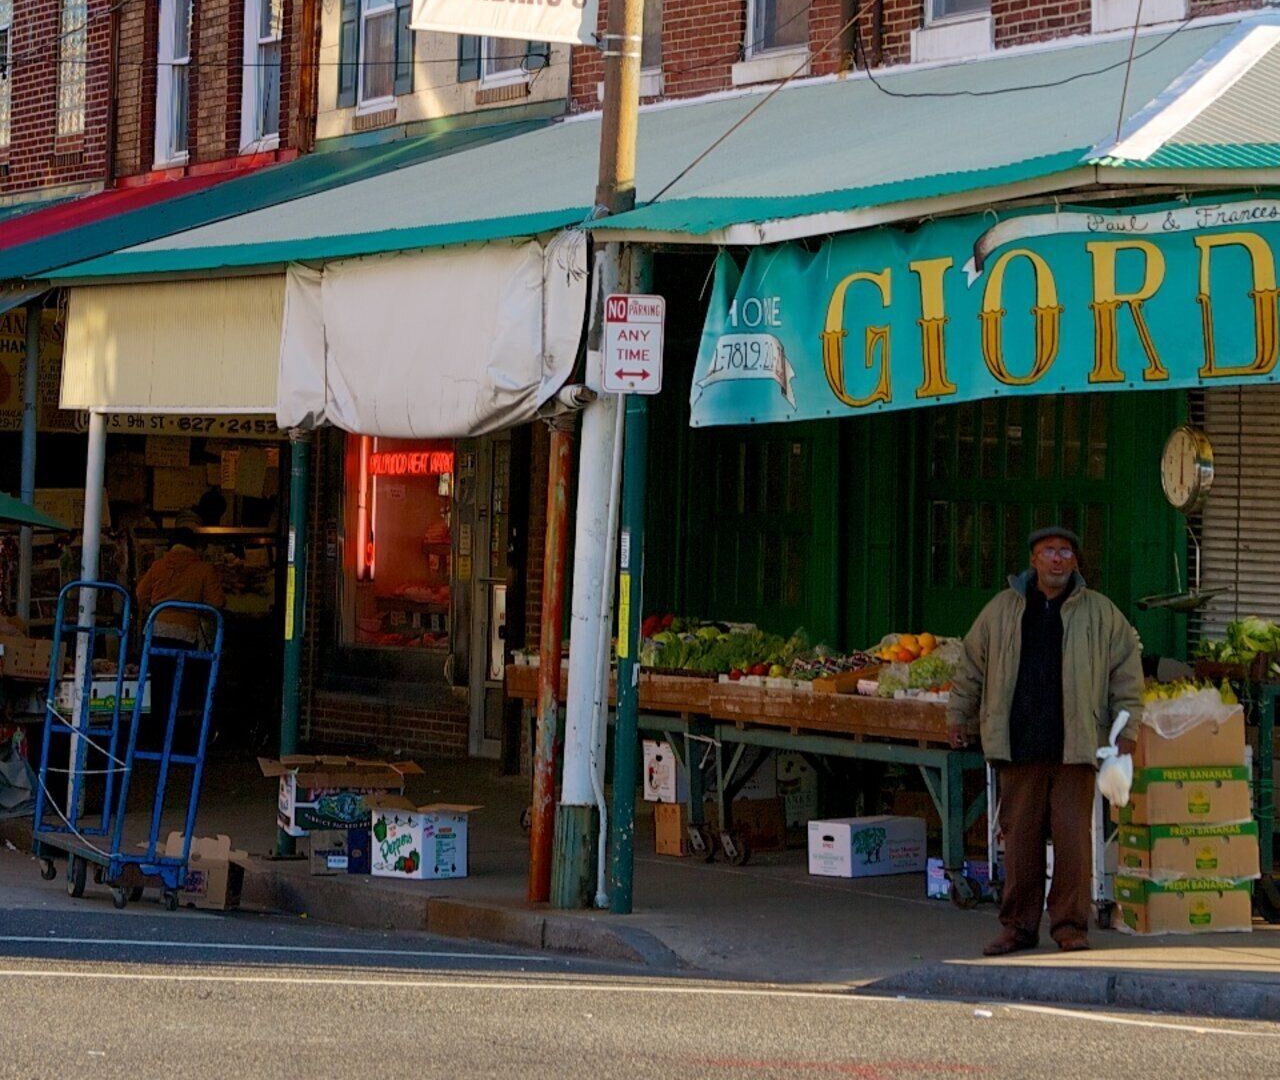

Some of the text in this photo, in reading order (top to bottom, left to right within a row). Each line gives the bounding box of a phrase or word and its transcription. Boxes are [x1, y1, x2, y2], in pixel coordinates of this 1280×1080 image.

[1086, 214, 1148, 233] Paul
[1161, 212, 1181, 231] &
[608, 299, 661, 320] NO PARKING
[618, 329, 651, 342] ANY
[617, 348, 651, 362] TIME
[128, 416, 145, 428] 9th
[1163, 769, 1233, 779] FRESH BANANAS
[1171, 824, 1241, 836] FRESH BANANAS
